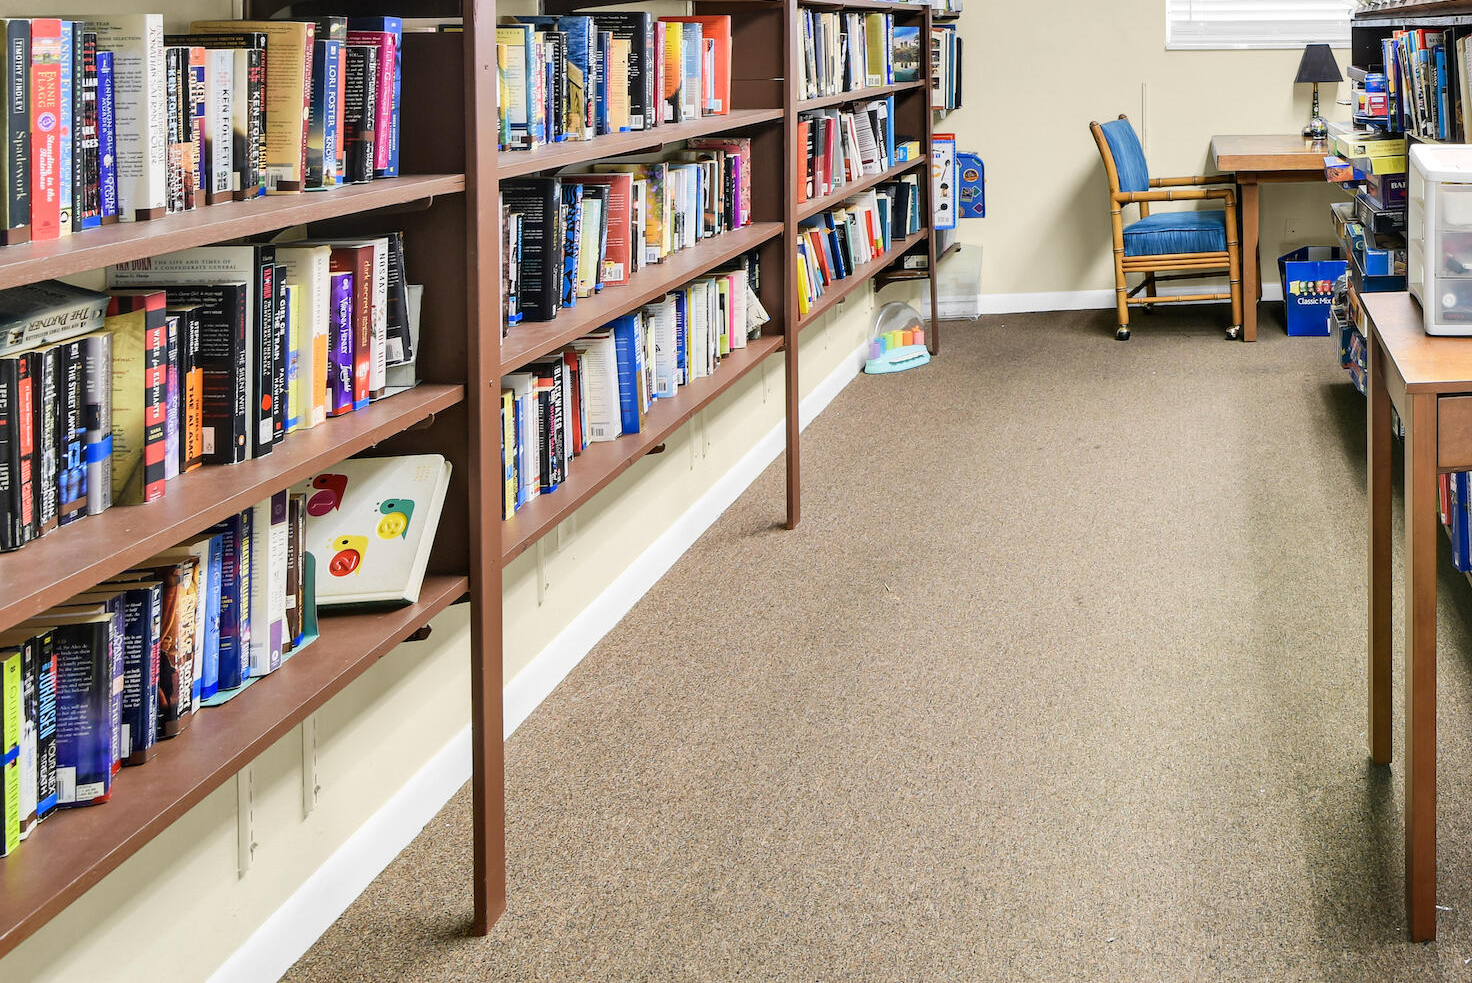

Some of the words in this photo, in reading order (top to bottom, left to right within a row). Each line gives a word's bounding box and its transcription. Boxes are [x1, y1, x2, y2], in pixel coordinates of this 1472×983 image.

[14, 40, 23, 75] TIMOTHY
[14, 77, 23, 111] FINDLEY
[38, 71, 47, 108] FLAGG
[47, 71, 56, 108] FANNIE
[327, 65, 336, 89] LORI
[252, 91, 260, 111] KEN
[327, 91, 336, 127] FOSTER
[44, 134, 55, 173] Standing
[251, 114, 260, 172] FOLLETT
[14, 131, 27, 201] Spadework
[39, 148, 47, 190] Rainbow
[45, 187, 54, 202] the
[152, 329, 161, 357] WATER
[68, 364, 78, 380] THE
[68, 382, 77, 411] STREET
[152, 371, 161, 419] ELEPHANTS
[67, 413, 77, 441] LAWYER
[39, 672, 56, 739] JOHANSEN
